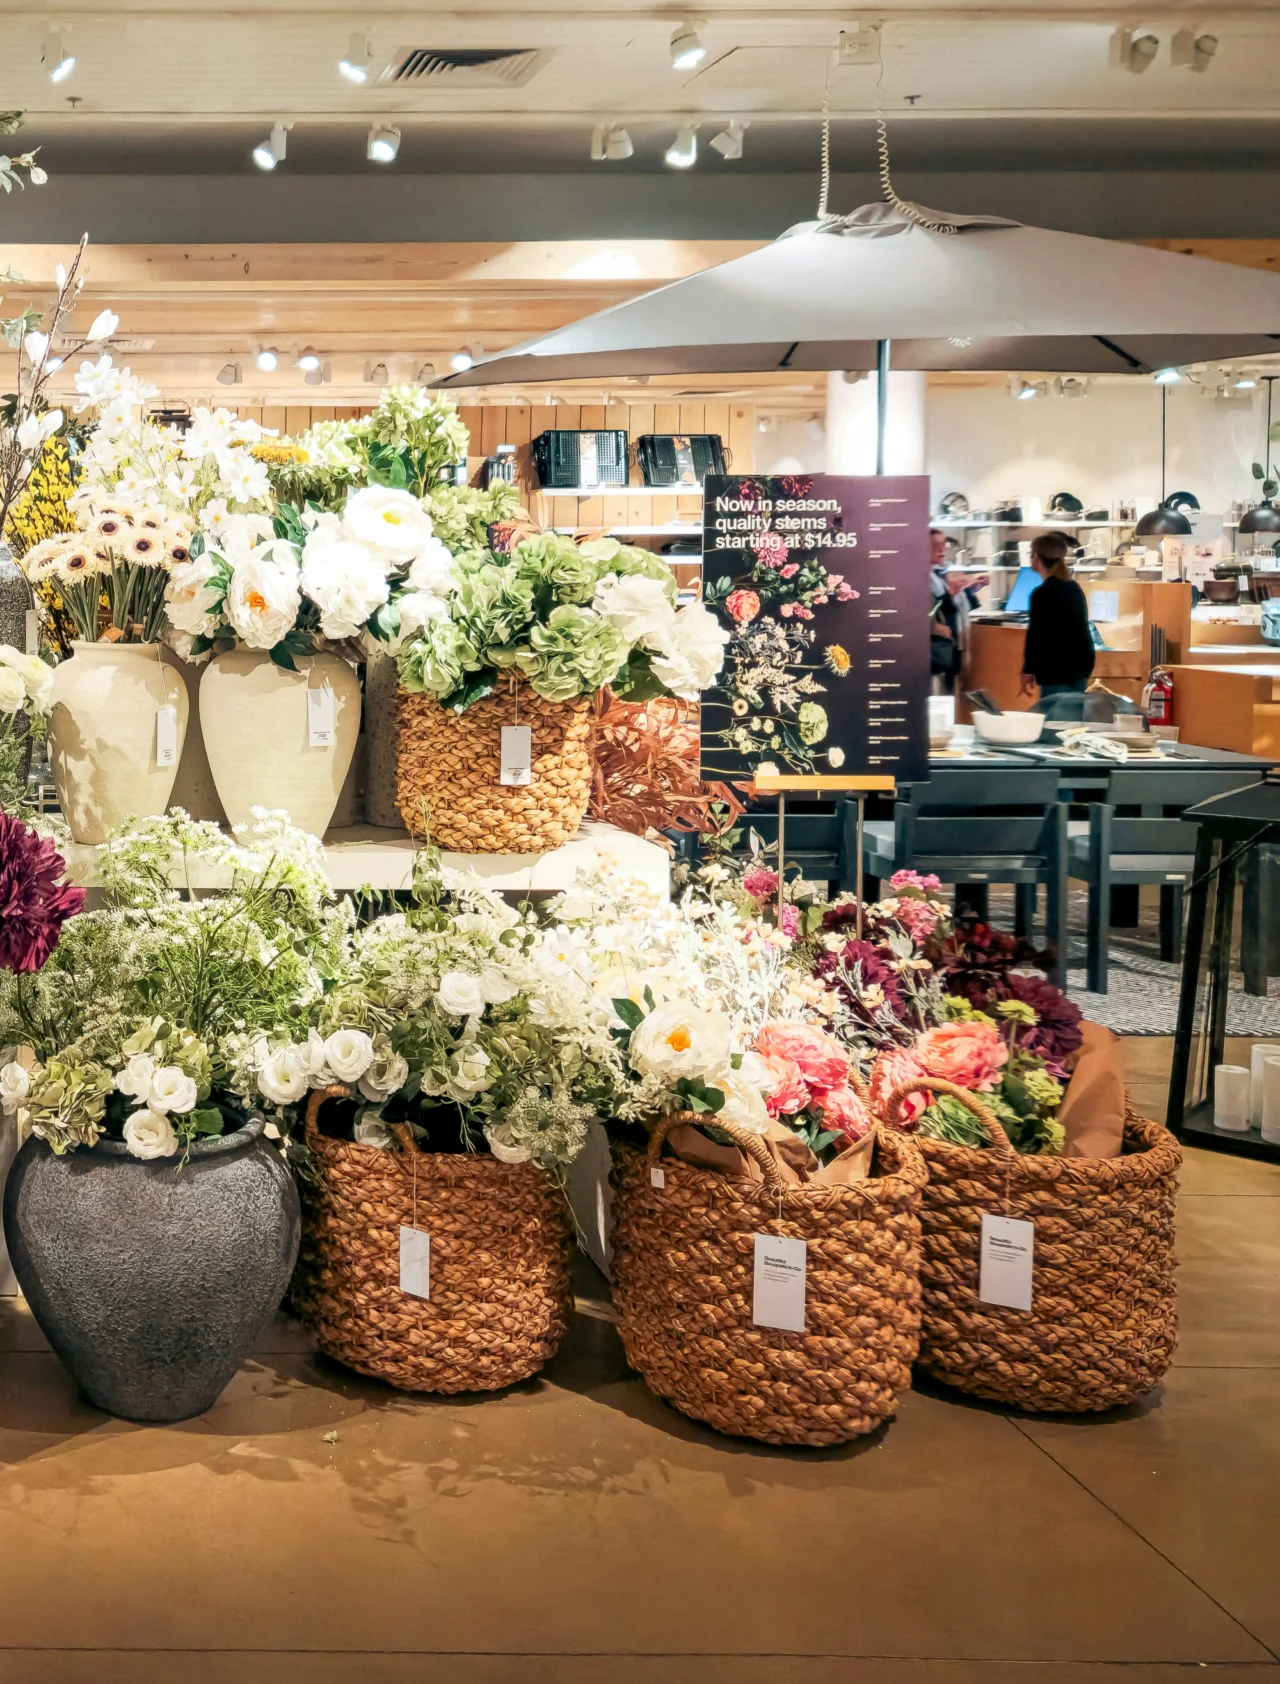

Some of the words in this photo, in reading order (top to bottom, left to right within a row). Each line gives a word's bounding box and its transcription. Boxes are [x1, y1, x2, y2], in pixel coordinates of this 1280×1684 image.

[715, 496, 754, 512] Now
[757, 497, 773, 512] in
[775, 498, 842, 514] season,
[715, 514, 772, 533] quality
[775, 515, 827, 530] stems
[715, 533, 781, 551] starting
[783, 533, 801, 548] at
[804, 532, 858, 550] $14.95
